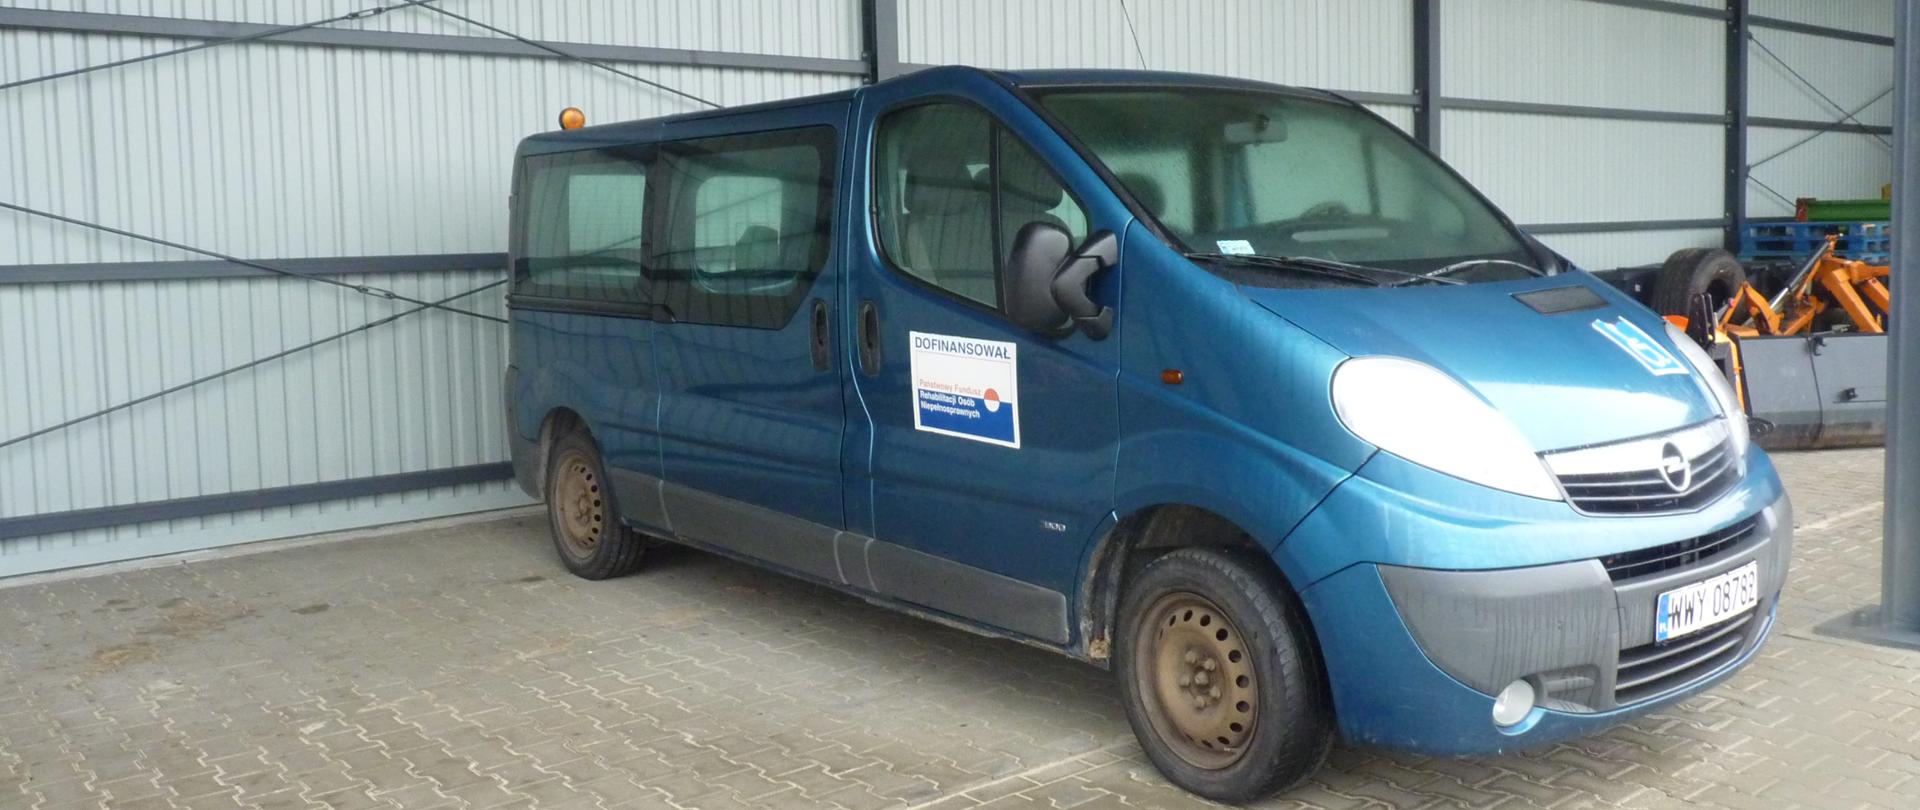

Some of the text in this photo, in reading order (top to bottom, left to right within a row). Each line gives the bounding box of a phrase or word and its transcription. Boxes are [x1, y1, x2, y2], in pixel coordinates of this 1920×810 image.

[914, 336, 1011, 359] DOFINANSOWAŁ
[920, 390, 975, 407] Rehabilitacji Osób
[954, 384, 981, 396] Fundusz
[1671, 571, 1755, 630] WWY 08782
